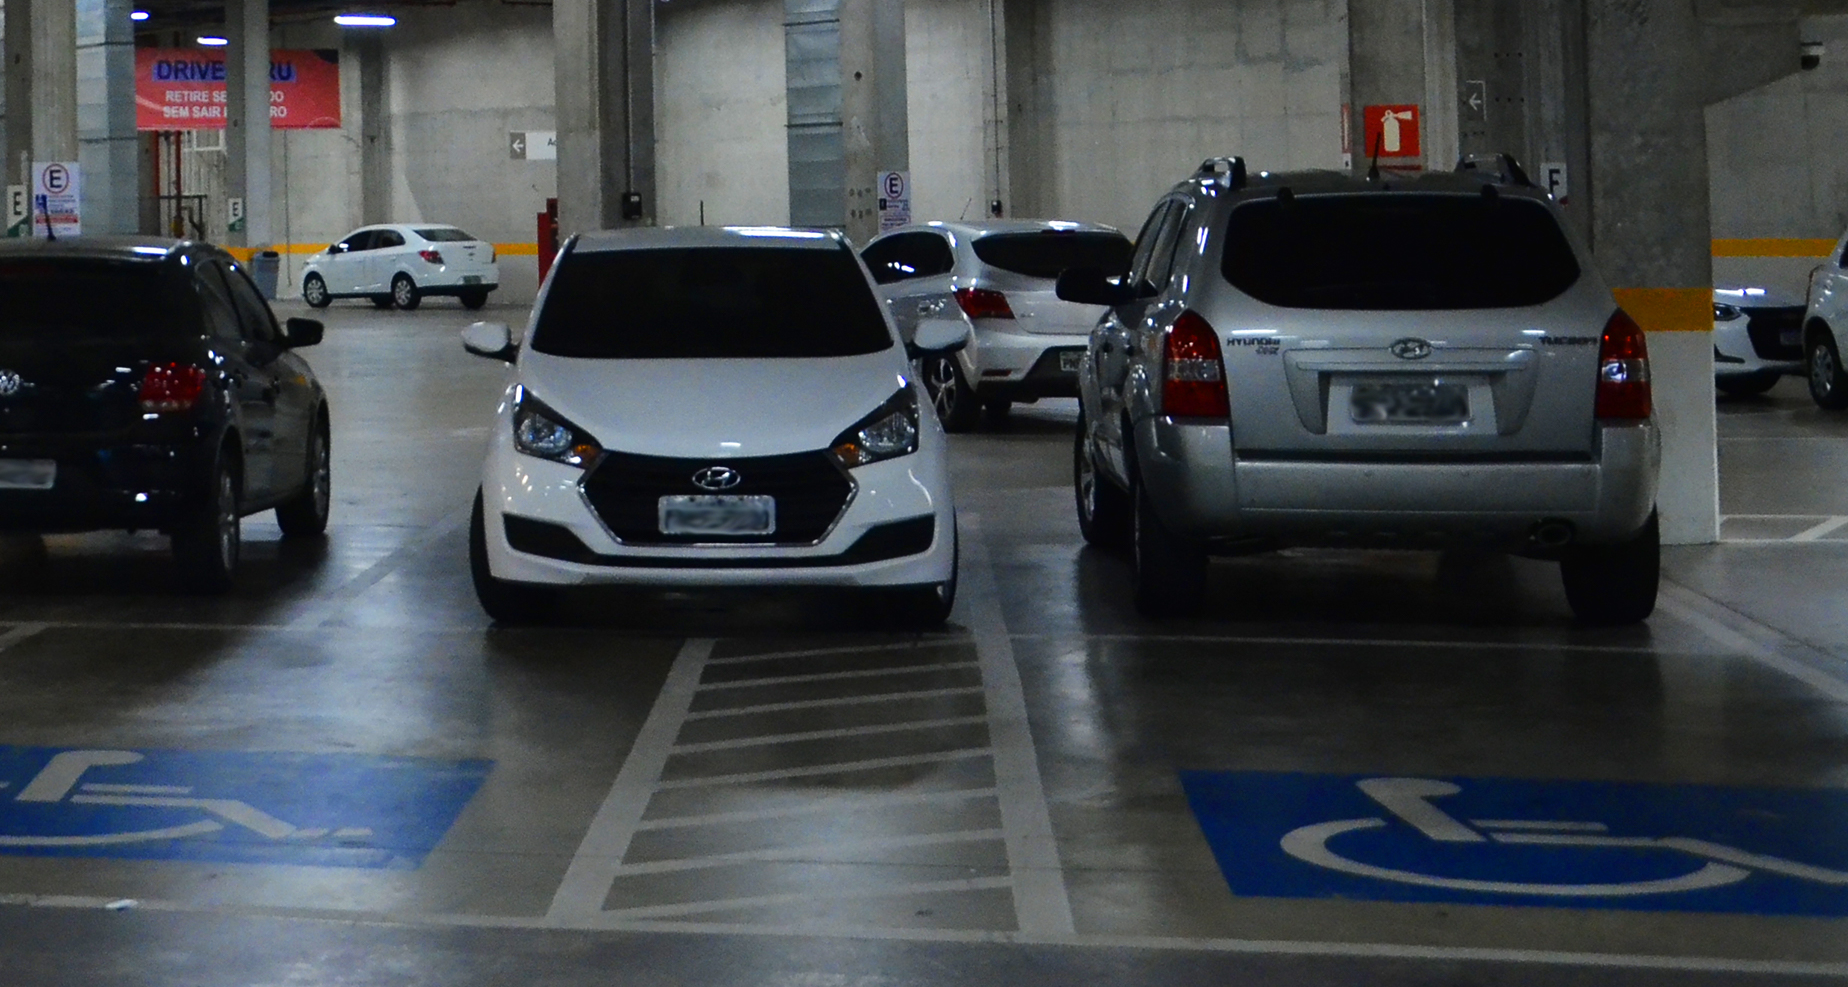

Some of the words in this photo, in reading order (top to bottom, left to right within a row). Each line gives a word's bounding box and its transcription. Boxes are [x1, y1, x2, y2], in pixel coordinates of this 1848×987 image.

[156, 60, 227, 80] DRIVE
[165, 90, 209, 103] RETIRE
[163, 105, 190, 118] SEM
[192, 105, 221, 118] SAIR
[48, 169, 63, 189] E
[888, 177, 899, 194] E
[13, 191, 22, 216] E
[232, 201, 240, 217] E
